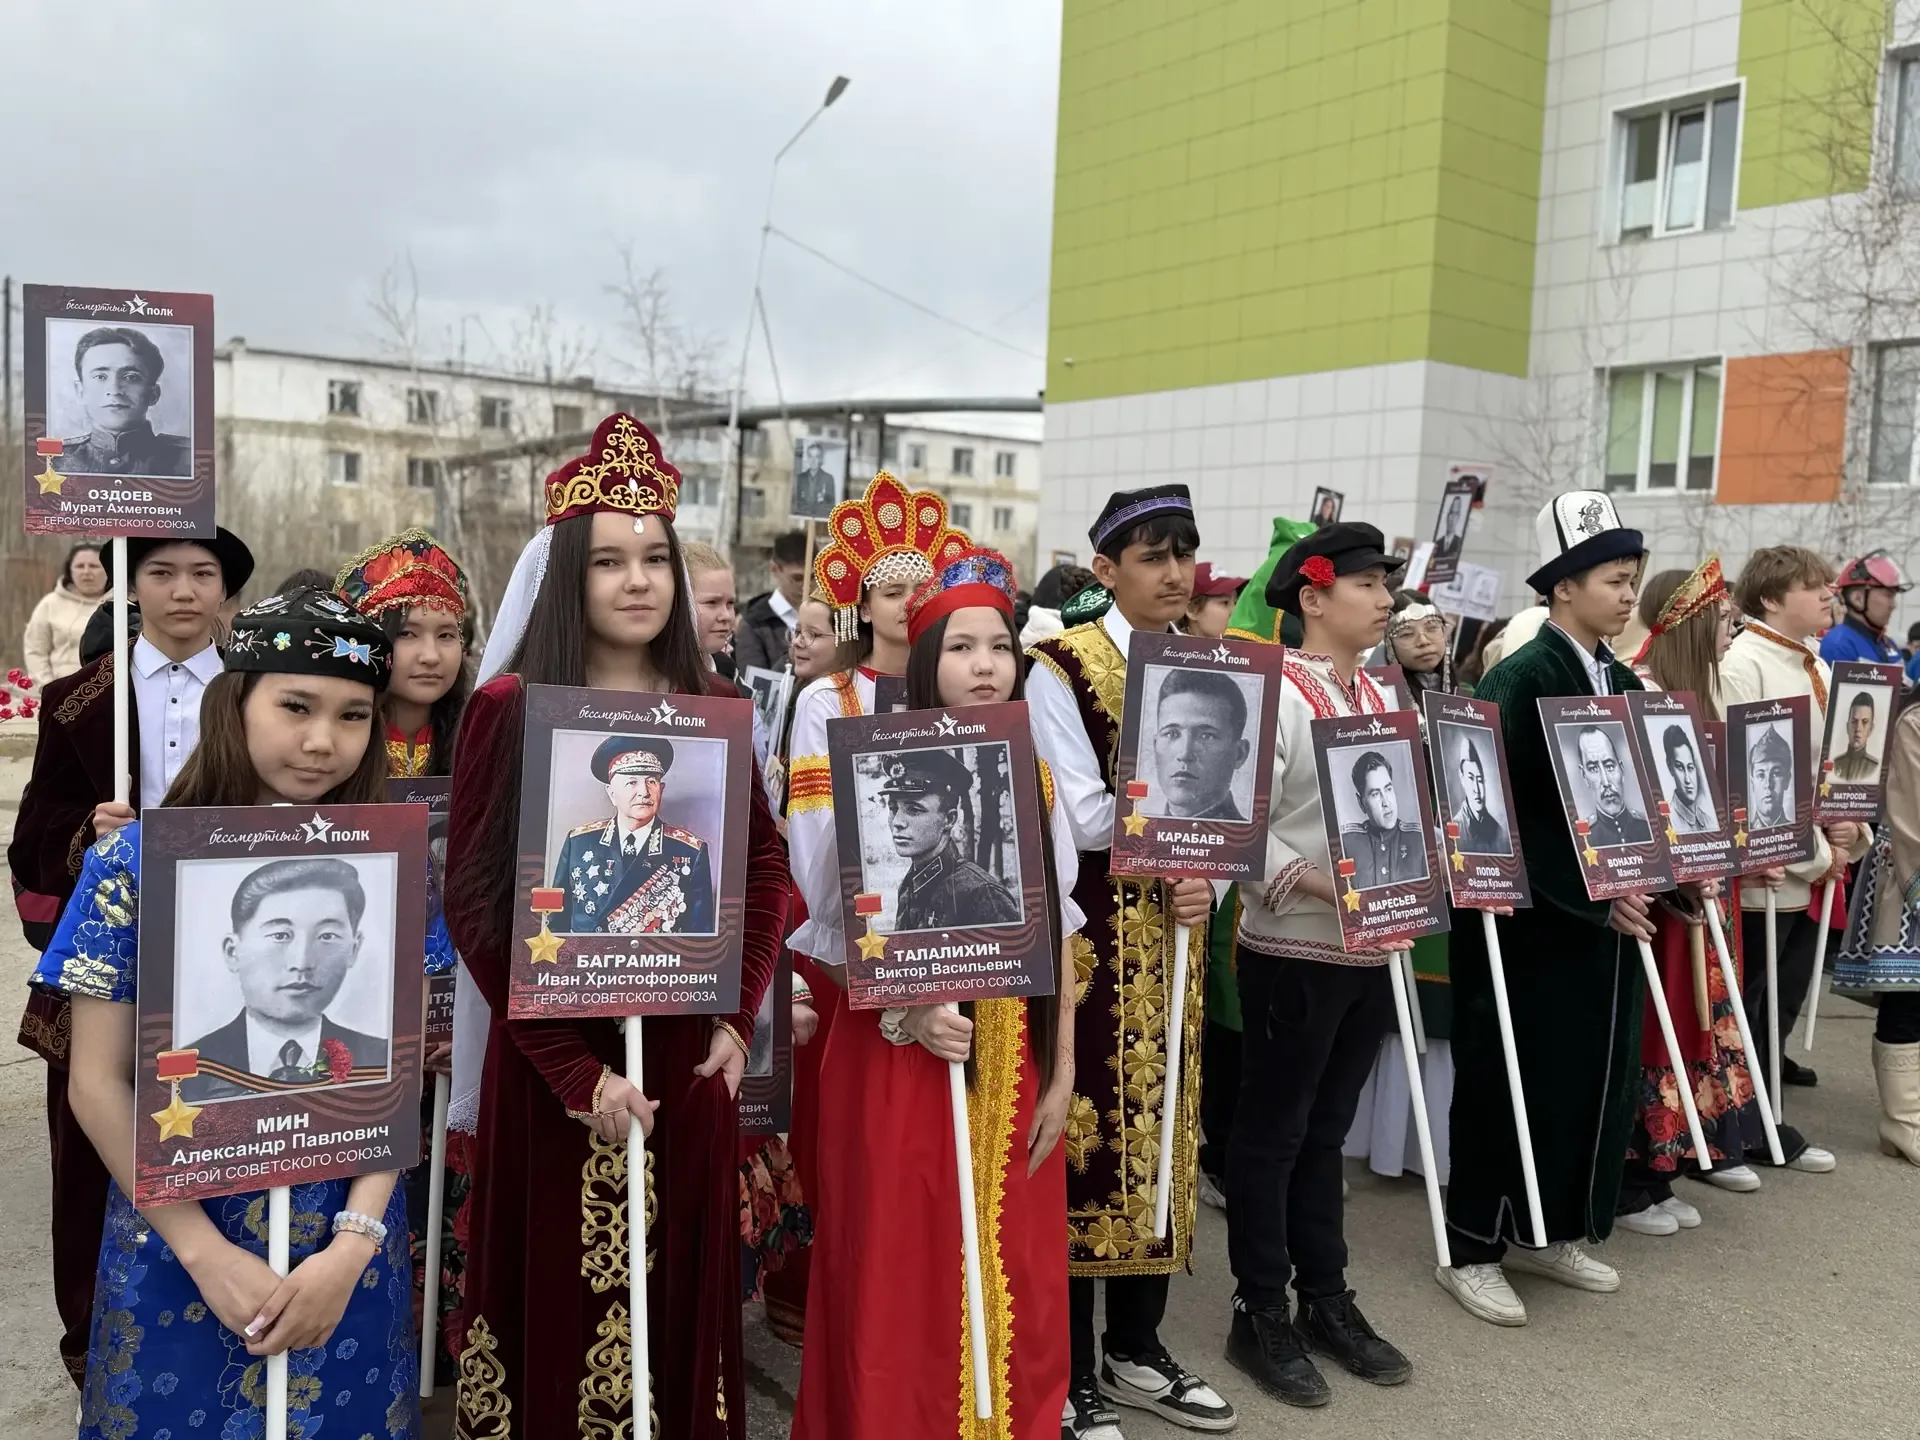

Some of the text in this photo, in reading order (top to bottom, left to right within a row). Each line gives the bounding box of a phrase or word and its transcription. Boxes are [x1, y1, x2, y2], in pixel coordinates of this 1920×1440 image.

[66, 298, 127, 316] бессмертный
[88, 489, 153, 502] ОЗДОЕВ
[60, 502, 182, 516] Мурат Ахметович
[44, 515, 196, 530] ГЕРОЙ СОВЕТСКОГО СОЮЗА
[1162, 646, 1213, 664] бессмертный
[579, 704, 652, 727] бессмертный
[872, 725, 936, 745] бессмертный
[208, 827, 302, 851] бессмертный
[1157, 831, 1225, 846] КАРАБАЕВ
[1750, 831, 1794, 847] ПРОКОПЬЕВ
[1171, 845, 1210, 857] Негмат
[1126, 857, 1250, 873] ГЕРОЙ СОВЕТСКОГО СОЮЗА
[1607, 855, 1644, 868] ВОНАХУН
[1476, 866, 1500, 877] ПОПОВ
[1616, 868, 1641, 878] Мансуз
[1368, 894, 1417, 912] МАРЕСЬЕВ
[1391, 905, 1429, 920] Петрович
[1354, 916, 1440, 941] ГЕРОЙ СОВЕТСКОГО СОЮЗА
[577, 953, 681, 969] БАГРАМЯН
[894, 942, 1000, 963] ТАЛАЛИХИН
[875, 959, 1022, 980] Виктор Васильевич
[537, 971, 718, 990] Иван Христофорович
[867, 975, 1032, 997] ГЕРОЙ СОВЕТСКОГО СОЮЗА
[533, 990, 718, 1005] ГЕРОЙ СОВЕТСКОГО СОЮЗА
[256, 1112, 309, 1135] МИН
[171, 1125, 389, 1166] Александр Павлович
[165, 1144, 392, 1189] ГЕРОЙ СОВЕТСКОГО СОЮЗА
